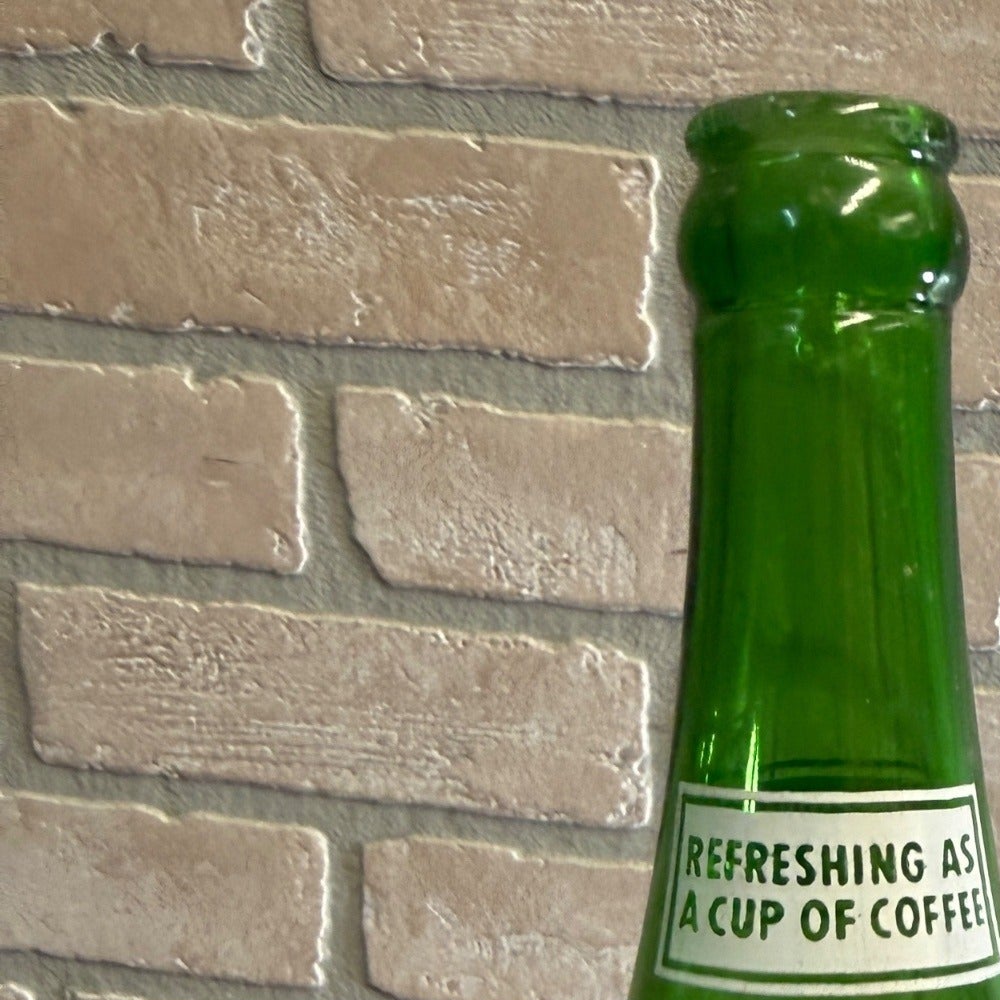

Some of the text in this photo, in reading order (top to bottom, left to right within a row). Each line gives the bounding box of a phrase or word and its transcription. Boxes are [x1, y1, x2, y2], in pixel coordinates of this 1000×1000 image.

[686, 833, 975, 886] REFRESHING AS
[679, 887, 985, 942] A CUP OF COFFEE
